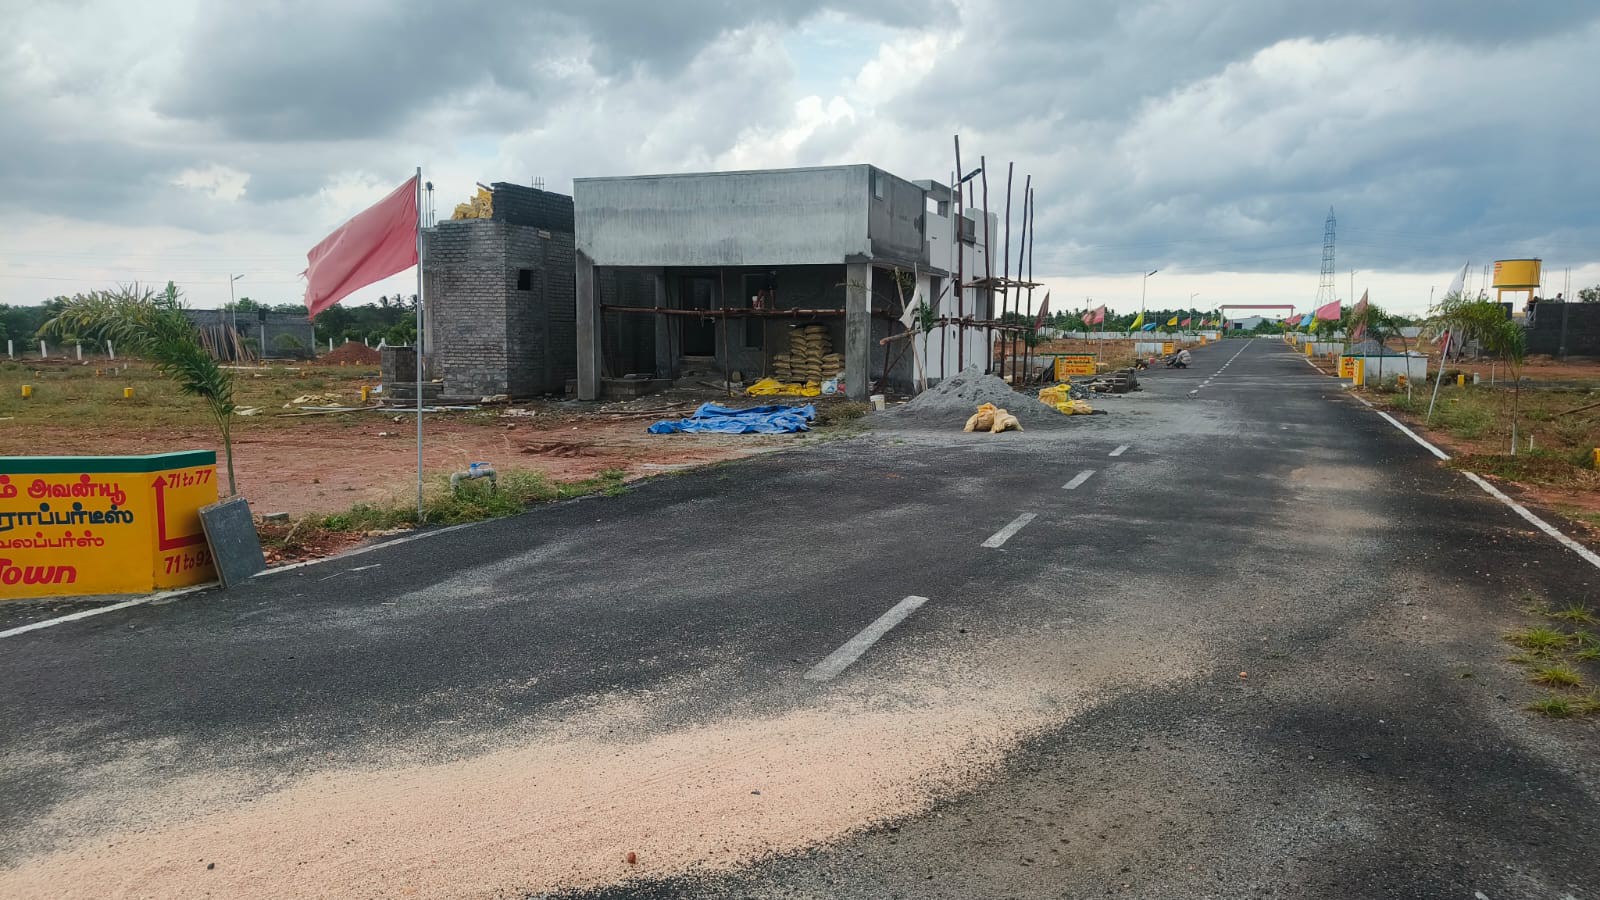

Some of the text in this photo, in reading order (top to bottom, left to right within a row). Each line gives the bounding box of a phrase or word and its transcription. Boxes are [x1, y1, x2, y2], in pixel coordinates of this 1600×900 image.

[28, 474, 126, 505] அவன்யூ
[168, 469, 212, 489] 71 to 77
[164, 554, 181, 575] 71
[184, 553, 194, 571] to
